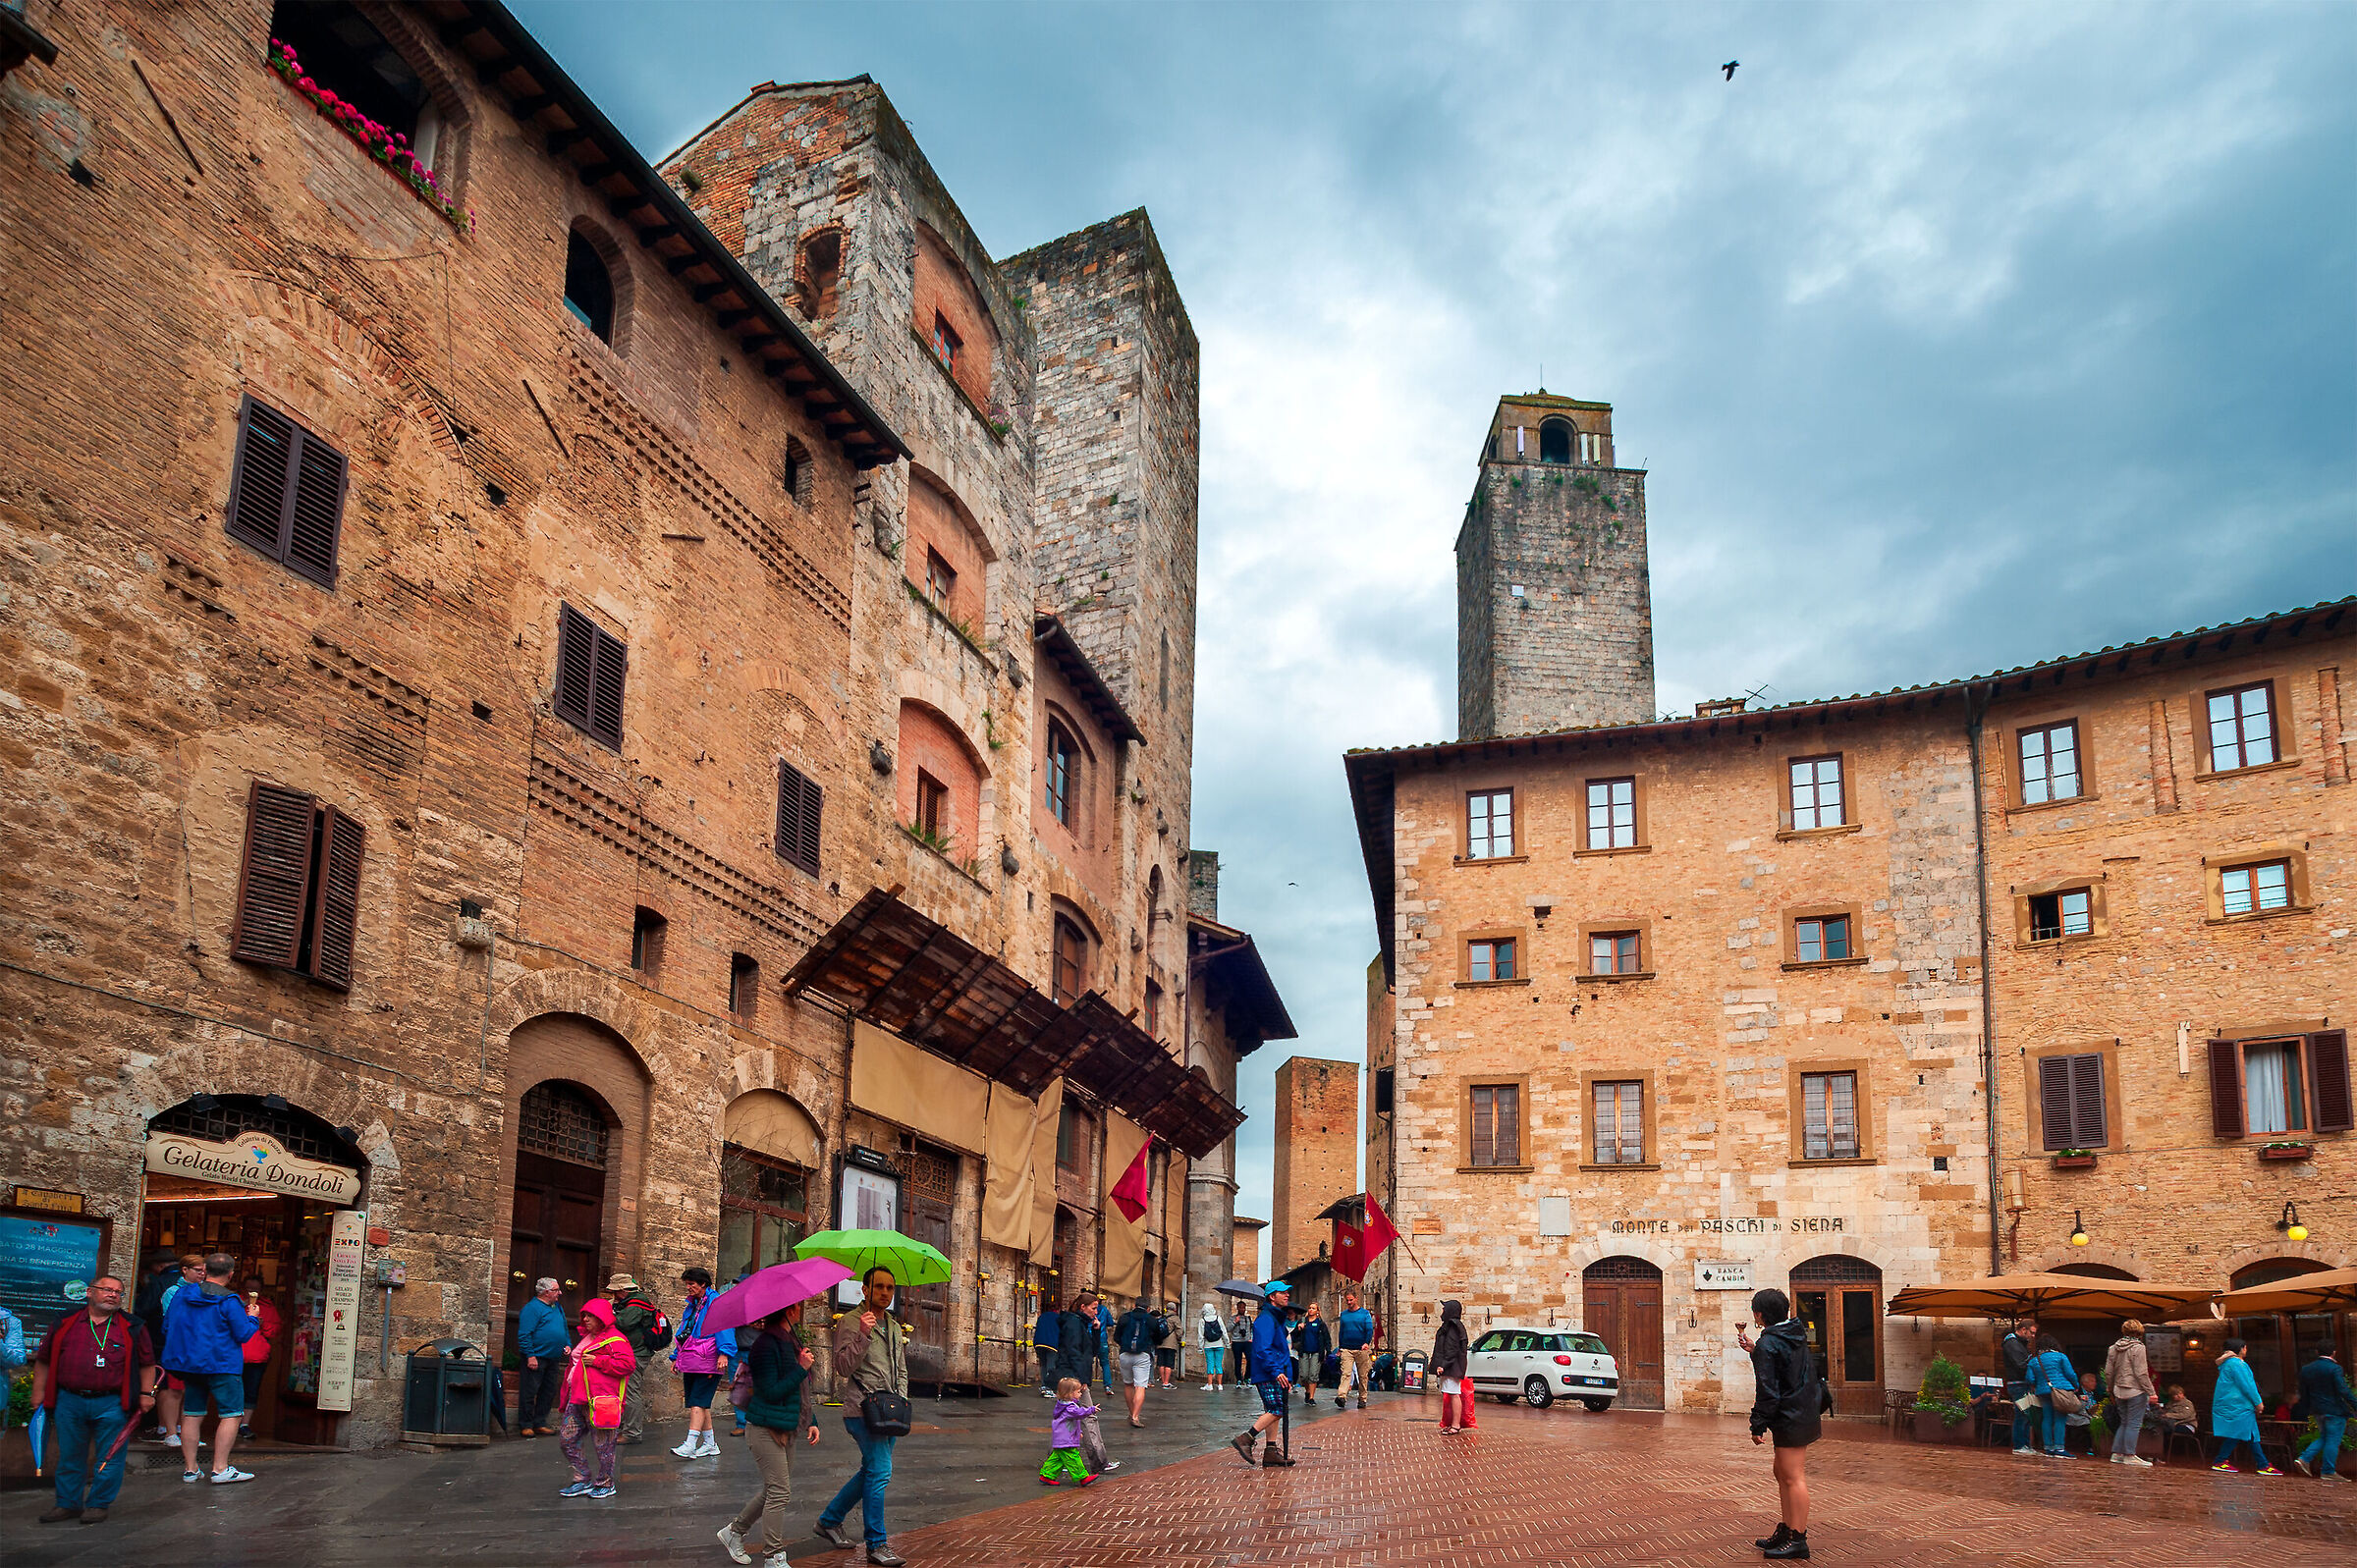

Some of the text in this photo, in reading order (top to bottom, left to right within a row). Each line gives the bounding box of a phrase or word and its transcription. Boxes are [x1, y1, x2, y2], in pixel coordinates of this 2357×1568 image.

[164, 1146, 345, 1194] Gelateria Dondoli
[201, 1170, 221, 1180] Gelato
[221, 1173, 239, 1182] World
[1612, 1220, 1670, 1233] MONTE
[1700, 1219, 1765, 1233] PASCHI
[1791, 1217, 1843, 1232] SIENA
[334, 1238, 360, 1247] EXPO
[37, 1245, 73, 1255] MAGGIO
[29, 1258, 86, 1270] BENEFICENZA
